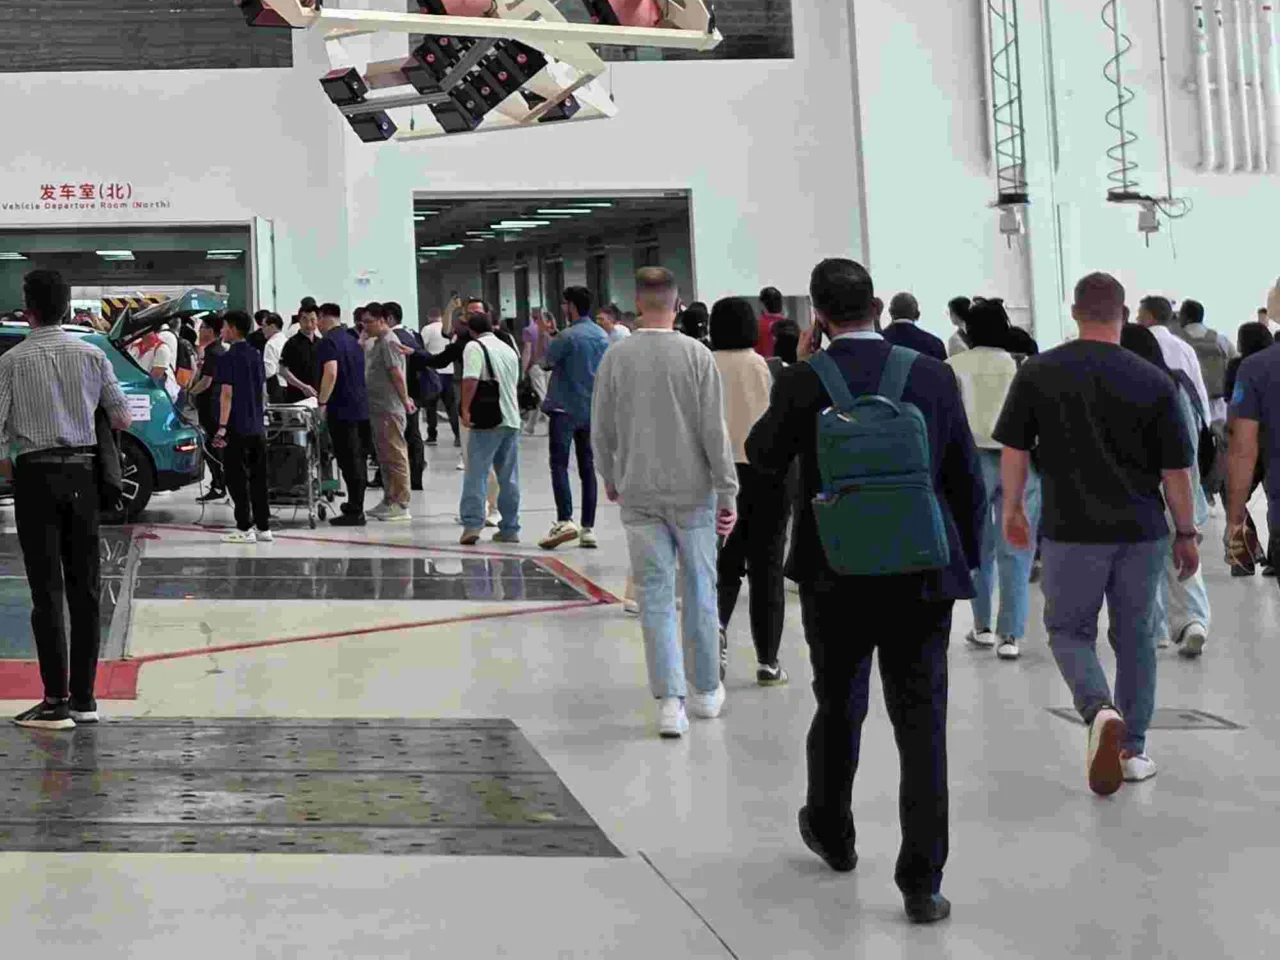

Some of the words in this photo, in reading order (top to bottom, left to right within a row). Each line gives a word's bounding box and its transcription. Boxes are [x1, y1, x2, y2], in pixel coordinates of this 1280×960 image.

[1, 202, 41, 211] Vehicle
[44, 202, 97, 212] Departure
[100, 201, 128, 209] Room
[132, 201, 171, 209] (North)
